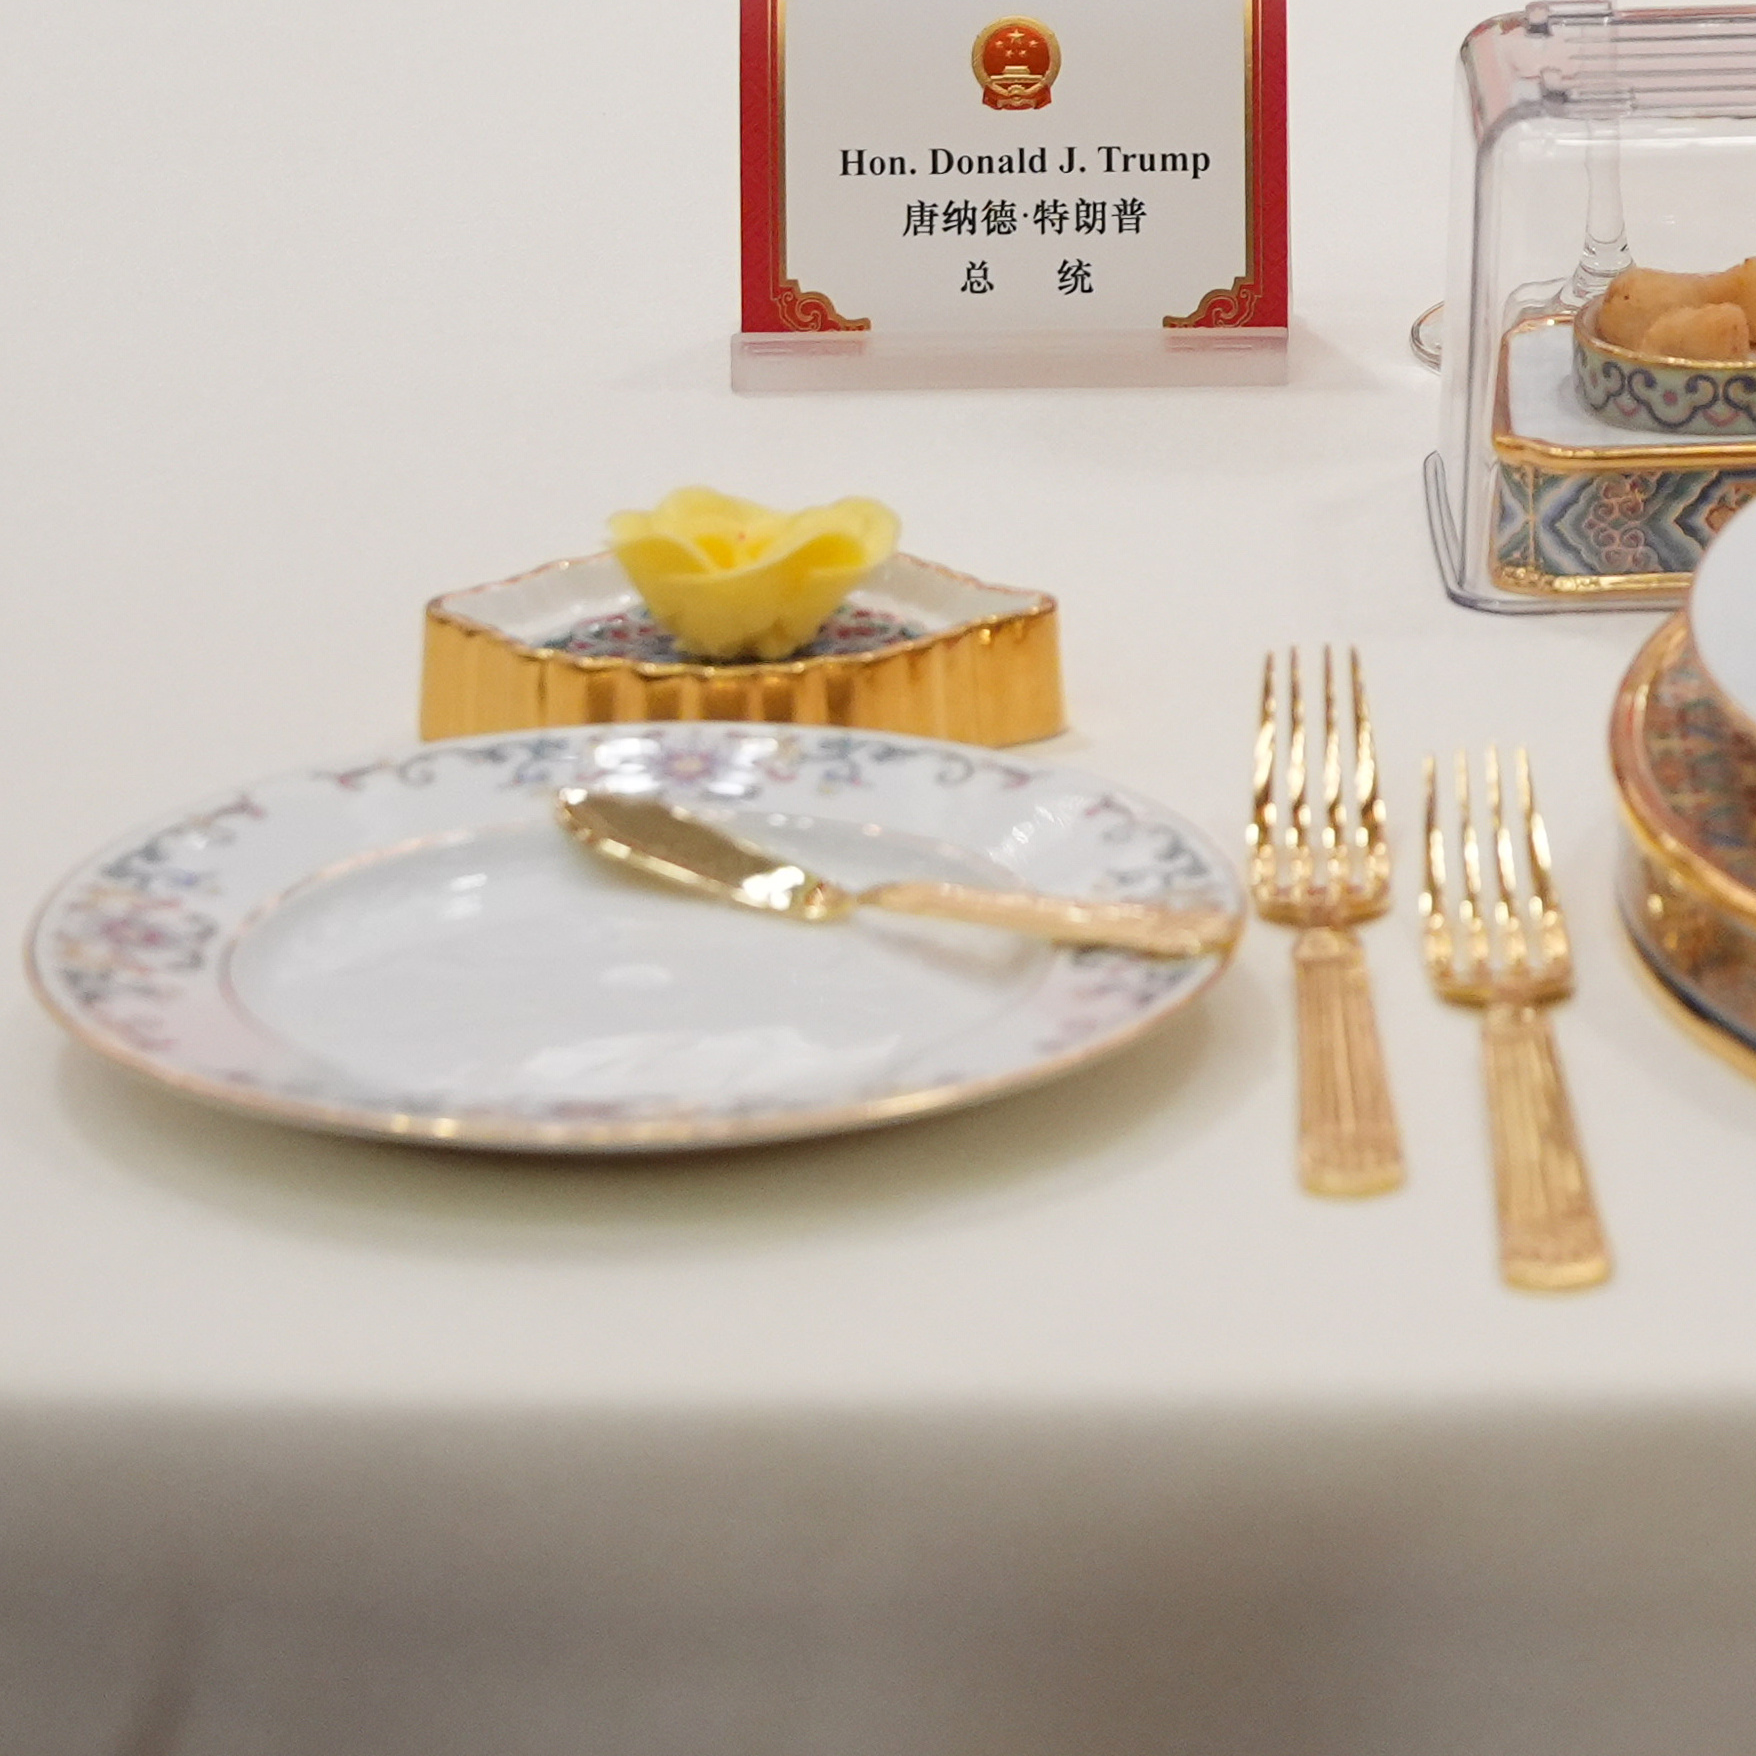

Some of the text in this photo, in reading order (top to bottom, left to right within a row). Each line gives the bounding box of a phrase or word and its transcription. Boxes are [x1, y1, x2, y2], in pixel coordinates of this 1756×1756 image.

[839, 145, 1211, 180] Hon. Donald J. Trump
[902, 197, 1148, 237] 唐纳德·特朗普
